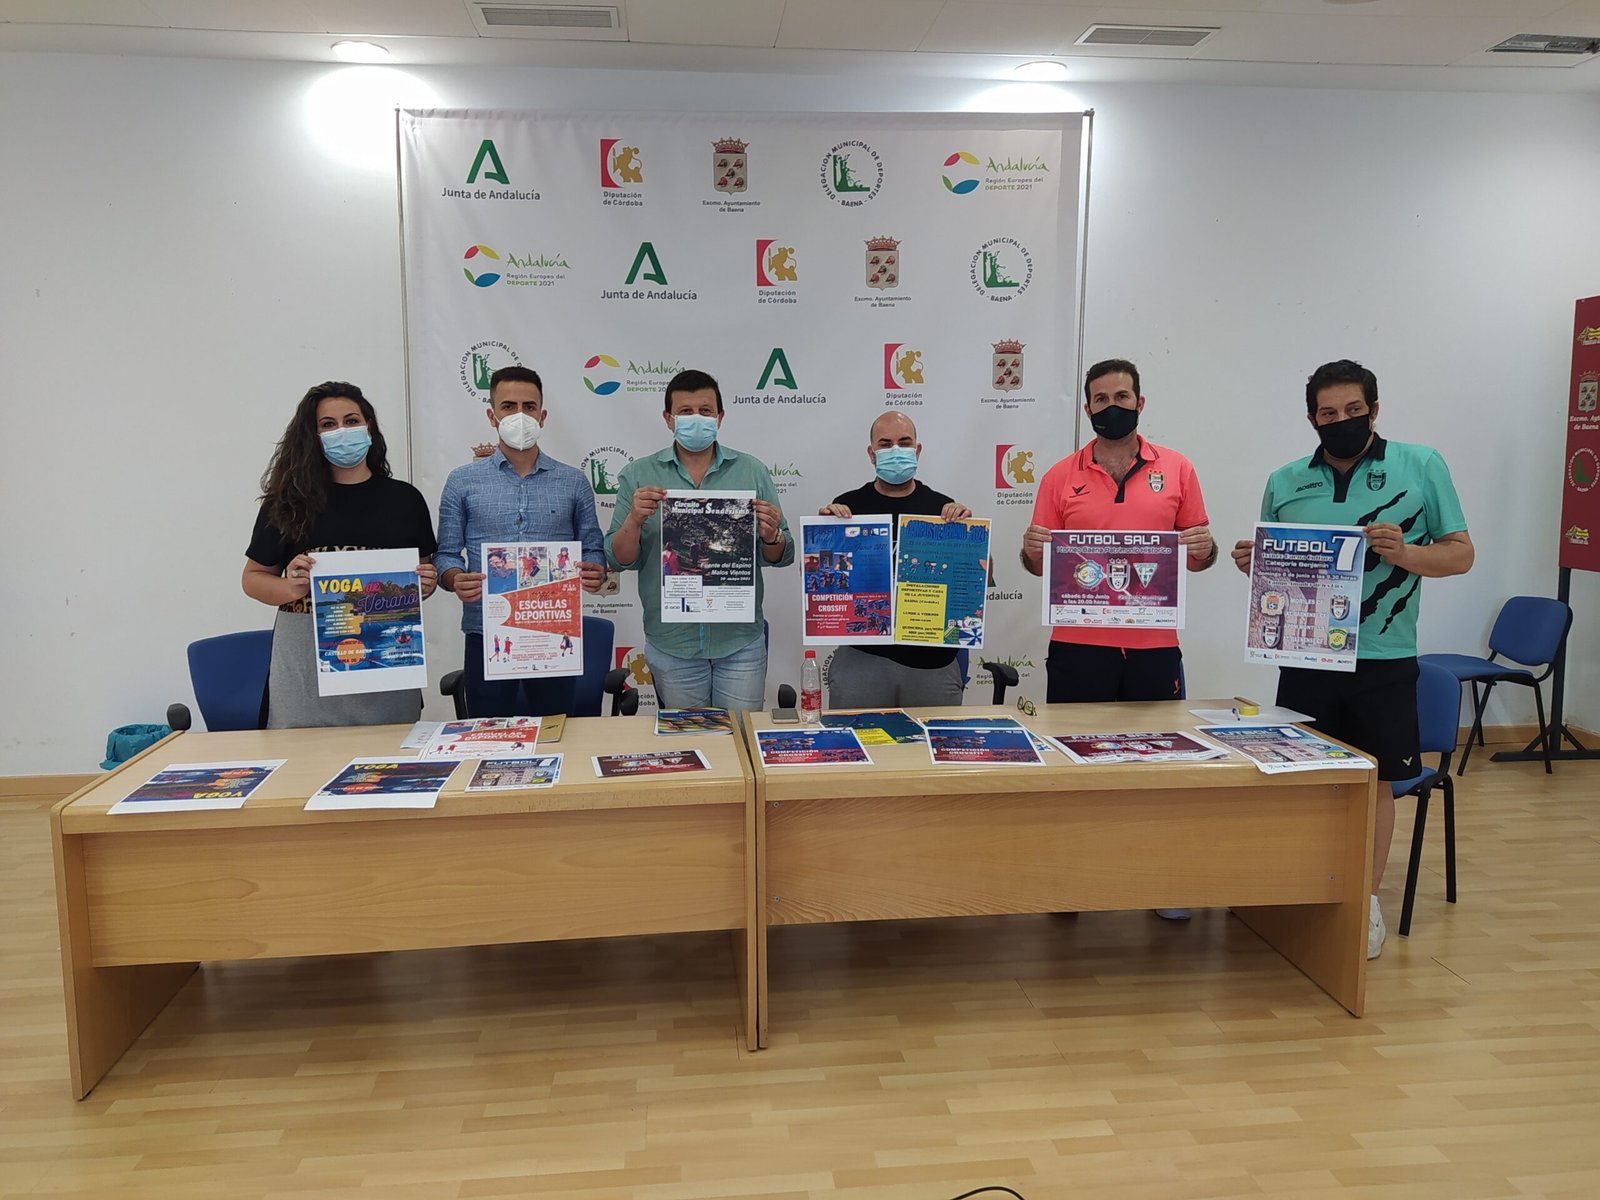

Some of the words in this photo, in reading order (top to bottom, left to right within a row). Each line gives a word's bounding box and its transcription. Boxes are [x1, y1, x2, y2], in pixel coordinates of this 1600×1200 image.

[832, 140, 871, 154] MUNICIPAL
[870, 151, 881, 161] DE
[986, 155, 1050, 173] Andalucía
[820, 152, 837, 200] DELEGACION
[867, 162, 884, 200] DEPORTES
[441, 187, 471, 199] Junta
[473, 188, 487, 199] de
[488, 188, 542, 201] Andalucía
[603, 190, 642, 198] Diputación
[612, 199, 643, 207] Córdoba
[981, 237, 1021, 250] MUNICIPAL
[1020, 247, 1030, 257] DE
[507, 252, 571, 269] Andalucía
[506, 272, 528, 280] Región
[970, 249, 987, 296] DELEGACION
[1017, 258, 1034, 295] DEPORTES
[600, 290, 630, 300] Junta
[632, 290, 645, 300] de
[647, 289, 698, 301] Andalucía
[758, 290, 796, 298] Diputación
[460, 350, 477, 397] DELEGACION
[470, 341, 510, 353] MUNICIPAL
[510, 351, 520, 361] DE
[626, 379, 647, 387] Región
[732, 395, 761, 405] Junta
[762, 395, 776, 404] de
[777, 393, 827, 404] Andalucía
[589, 446, 630, 458] MUNICIPAL
[671, 507, 704, 515] Municipal
[705, 502, 750, 515] Senderismo
[1069, 535, 1121, 545] FUTBOL
[1123, 535, 1161, 545] SALA
[1105, 546, 1140, 554] Patrimonio
[1262, 539, 1334, 553] FUTBOL
[1332, 536, 1361, 571] 7
[731, 562, 752, 570] Espino
[318, 578, 363, 594] YOGA
[357, 593, 419, 613] Verano
[812, 593, 854, 602] COMPETICIÓN
[519, 599, 568, 611] ESCUELAS
[515, 609, 572, 621] DEPORTIVAS
[193, 791, 243, 799] YOGA
